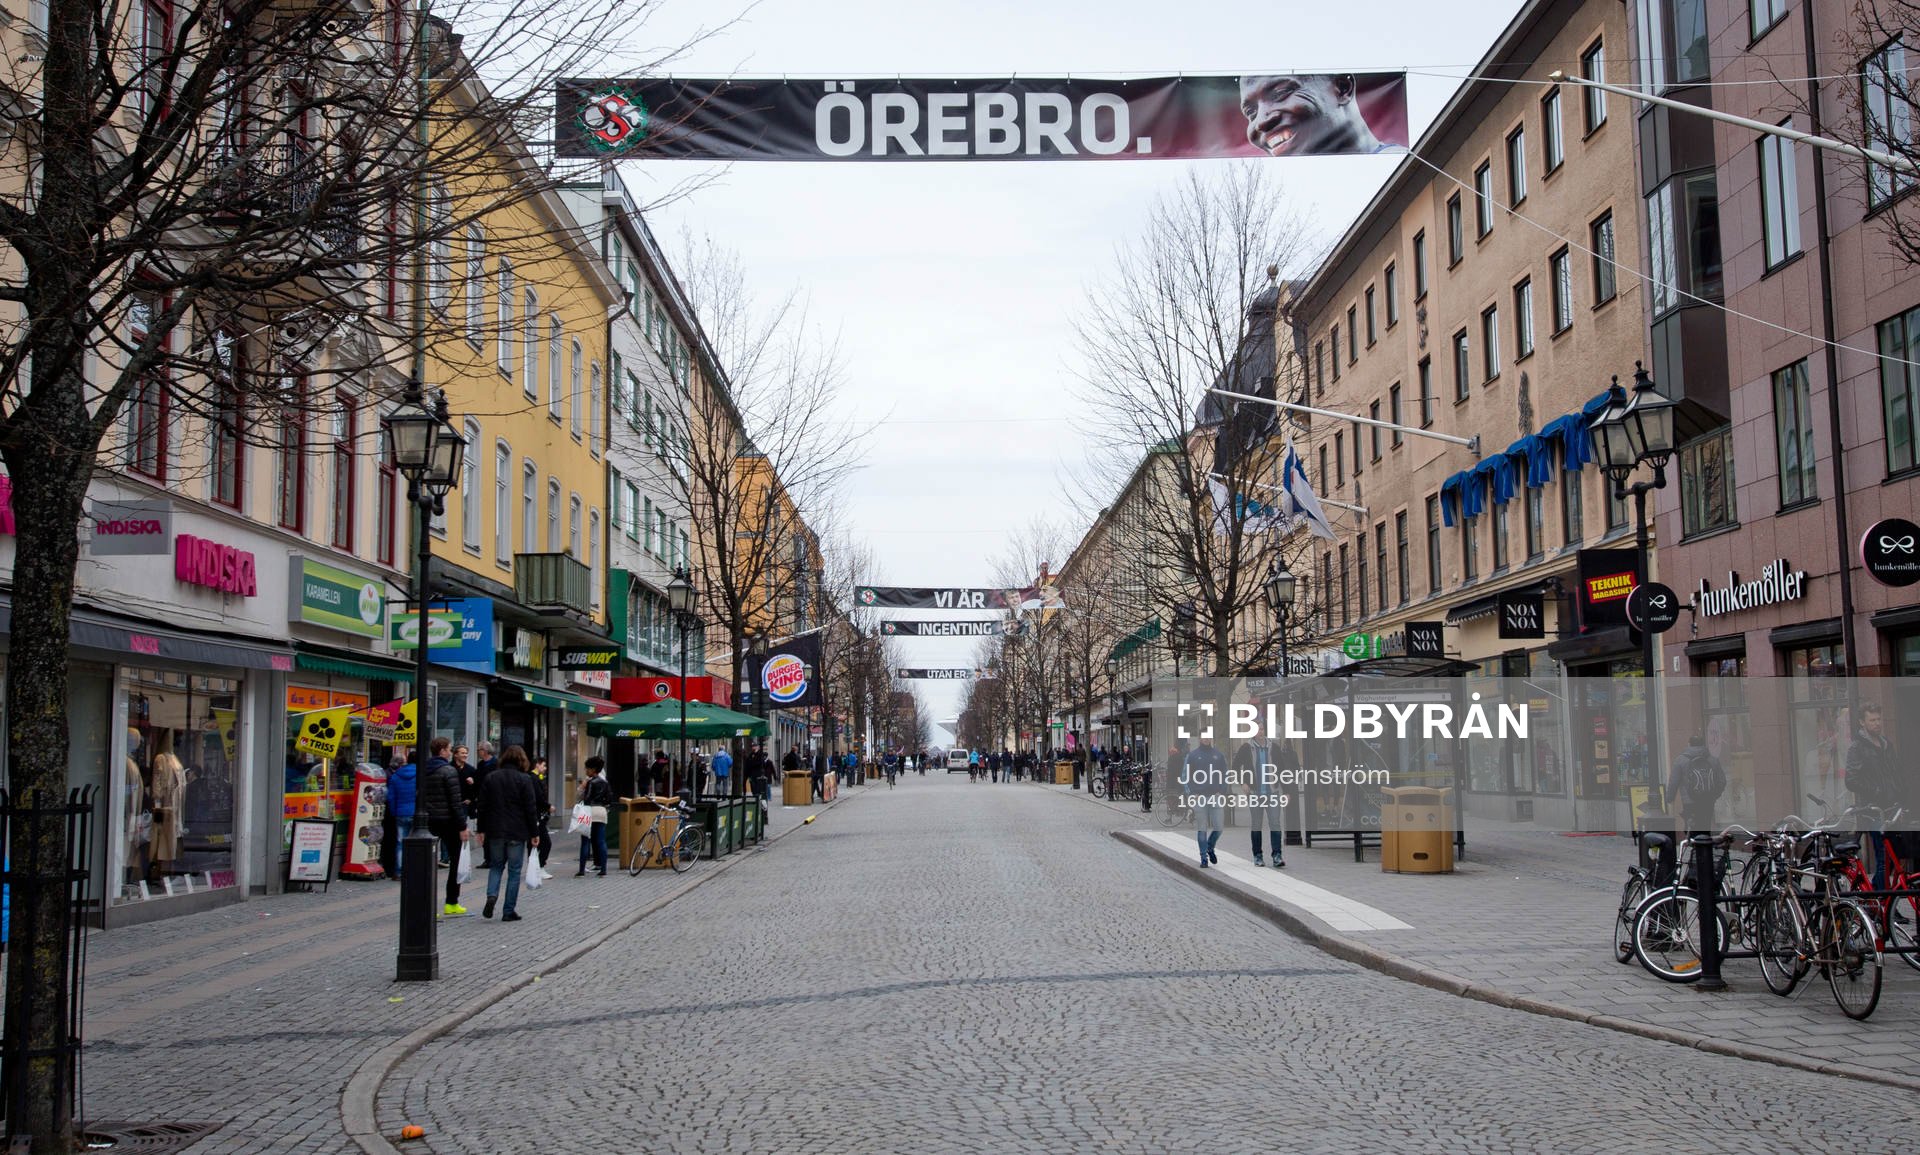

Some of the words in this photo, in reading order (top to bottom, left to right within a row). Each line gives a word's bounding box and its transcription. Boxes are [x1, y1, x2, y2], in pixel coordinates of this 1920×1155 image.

[814, 81, 1153, 156] ÖREBRO.
[97, 519, 162, 535] INDISKA
[175, 534, 257, 597] INDISKA
[1590, 574, 1632, 592] TEKNIK
[1700, 558, 1805, 617] hunkemöller
[306, 583, 341, 604] KARAMELLEN
[934, 591, 953, 608] VI
[957, 588, 986, 608] ÄR
[1506, 604, 1537, 616] NOA
[917, 622, 992, 635] INGENTING
[1506, 617, 1537, 629] NOA
[1411, 630, 1438, 641] NOA
[1412, 641, 1439, 652] NOA
[562, 652, 617, 664] SUBWAY
[768, 663, 800, 681] BURGER
[927, 670, 953, 678] UTAN
[770, 670, 803, 692] KING
[310, 739, 335, 753] TRISS
